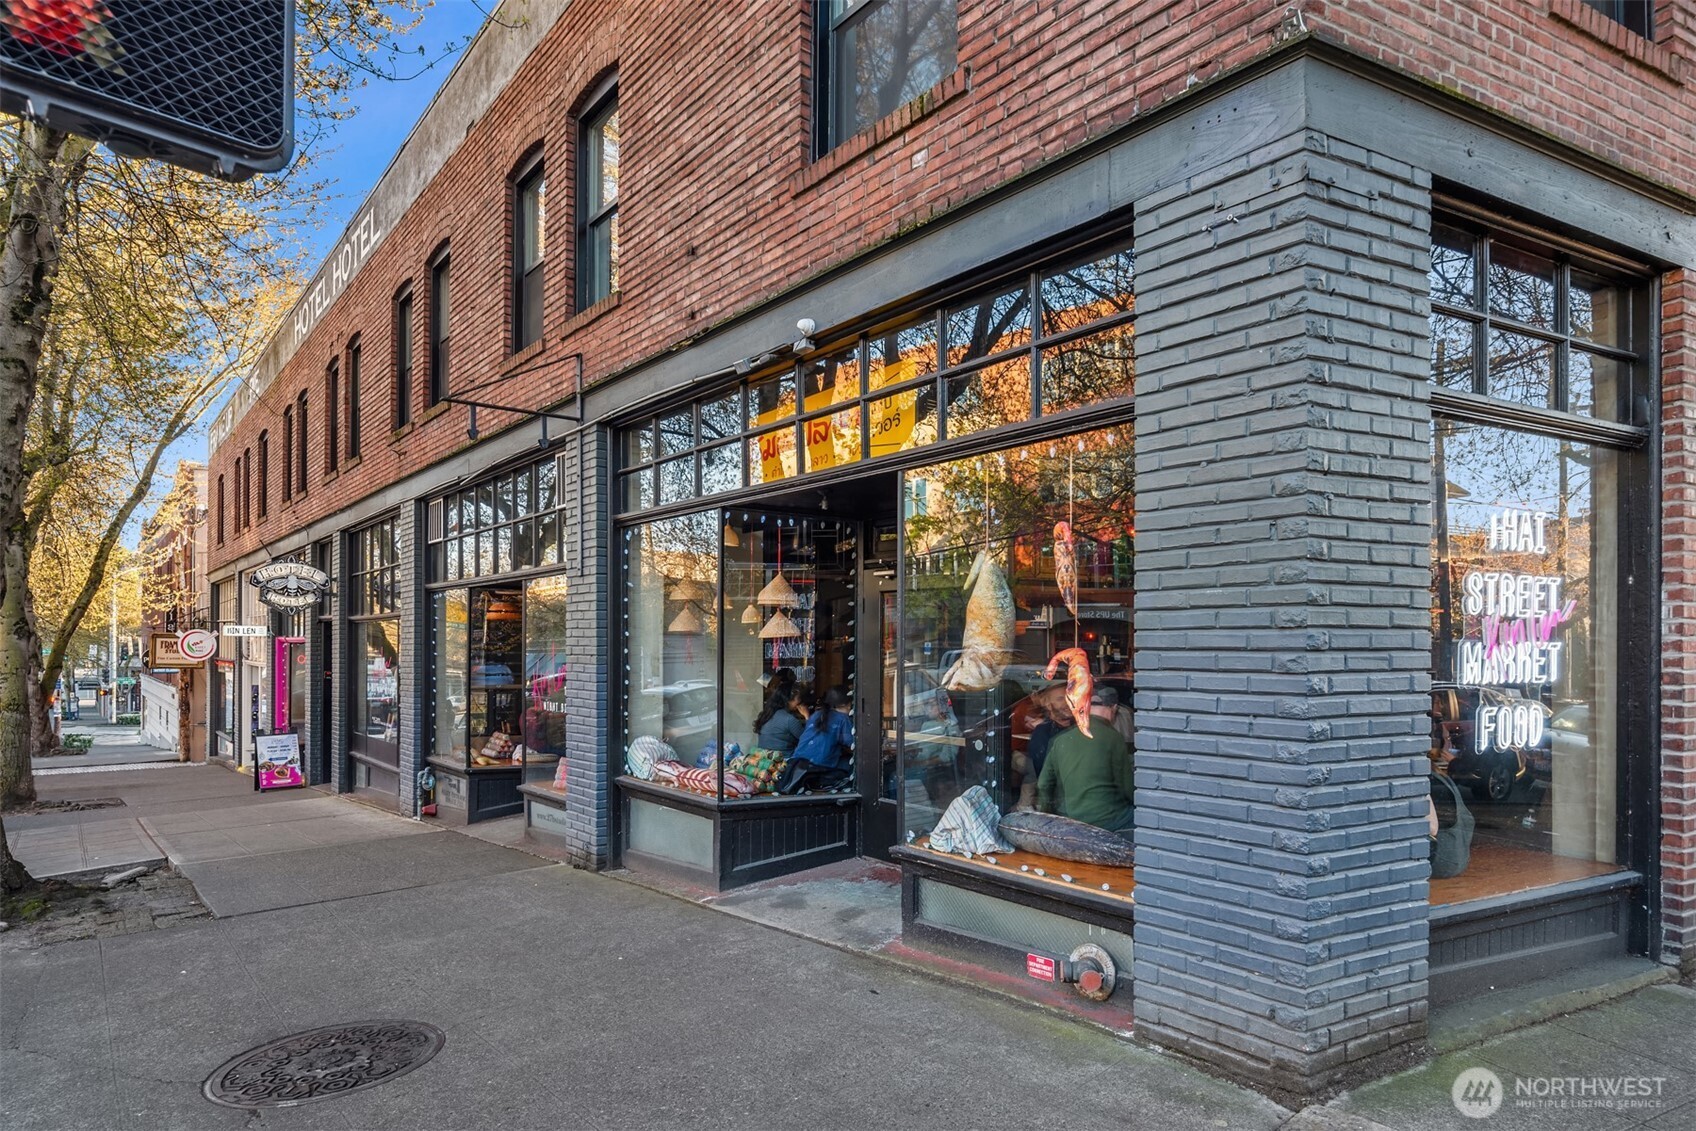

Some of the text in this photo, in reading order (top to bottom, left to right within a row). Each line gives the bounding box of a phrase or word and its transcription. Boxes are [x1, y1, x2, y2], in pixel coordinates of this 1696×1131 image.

[294, 206, 381, 345] HOTEL HOTEL
[259, 565, 322, 580] HOTEL
[1466, 571, 1562, 618] STREET
[268, 594, 312, 606] HOTEL
[242, 627, 257, 635] LEN
[1462, 640, 1562, 686] MARKET
[1480, 703, 1545, 751] FOOD
